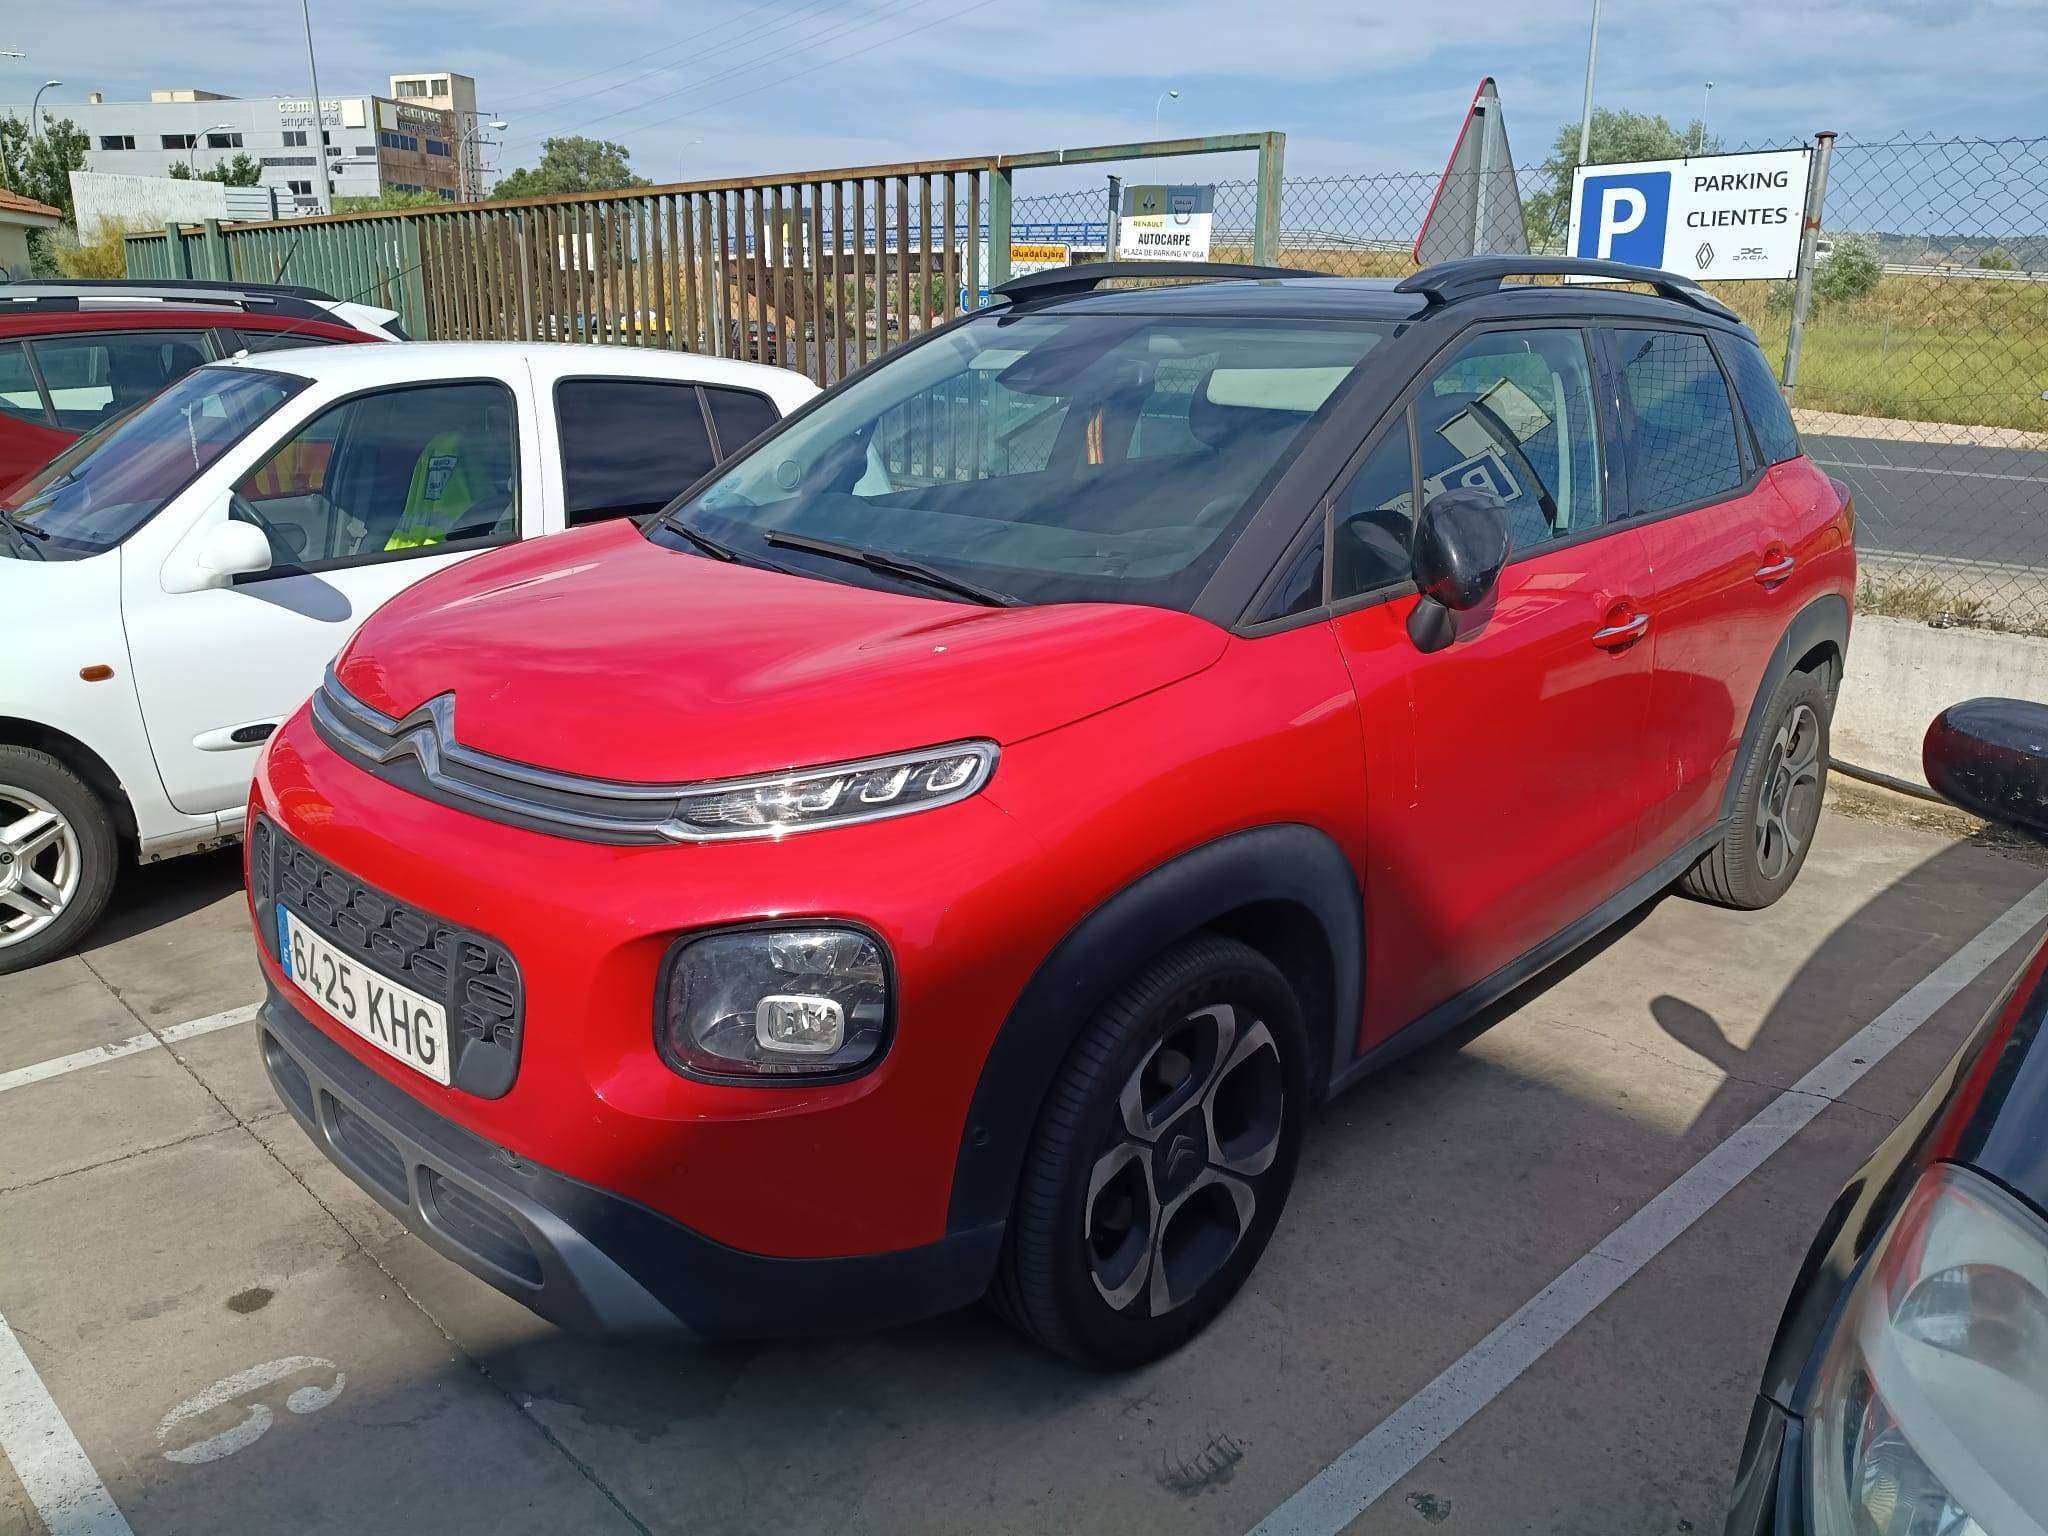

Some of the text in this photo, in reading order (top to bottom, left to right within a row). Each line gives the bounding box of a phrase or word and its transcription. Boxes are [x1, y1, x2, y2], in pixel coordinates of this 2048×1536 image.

[278, 101, 339, 114] camus
[396, 105, 442, 123] campus
[1694, 171, 1788, 192] PARKING
[1133, 220, 1164, 228] RENAULT
[1597, 187, 1647, 259] P
[1686, 207, 1788, 228] CLIENTES
[1138, 233, 1191, 246] AUTOCARPE
[1012, 249, 1064, 259] Guadalajara
[1123, 248, 1143, 256] PLAZA
[1143, 248, 1152, 256] DE
[1153, 250, 1181, 258] PARKING
[283, 947, 291, 963] E
[293, 930, 436, 1065] 6425 KHG
